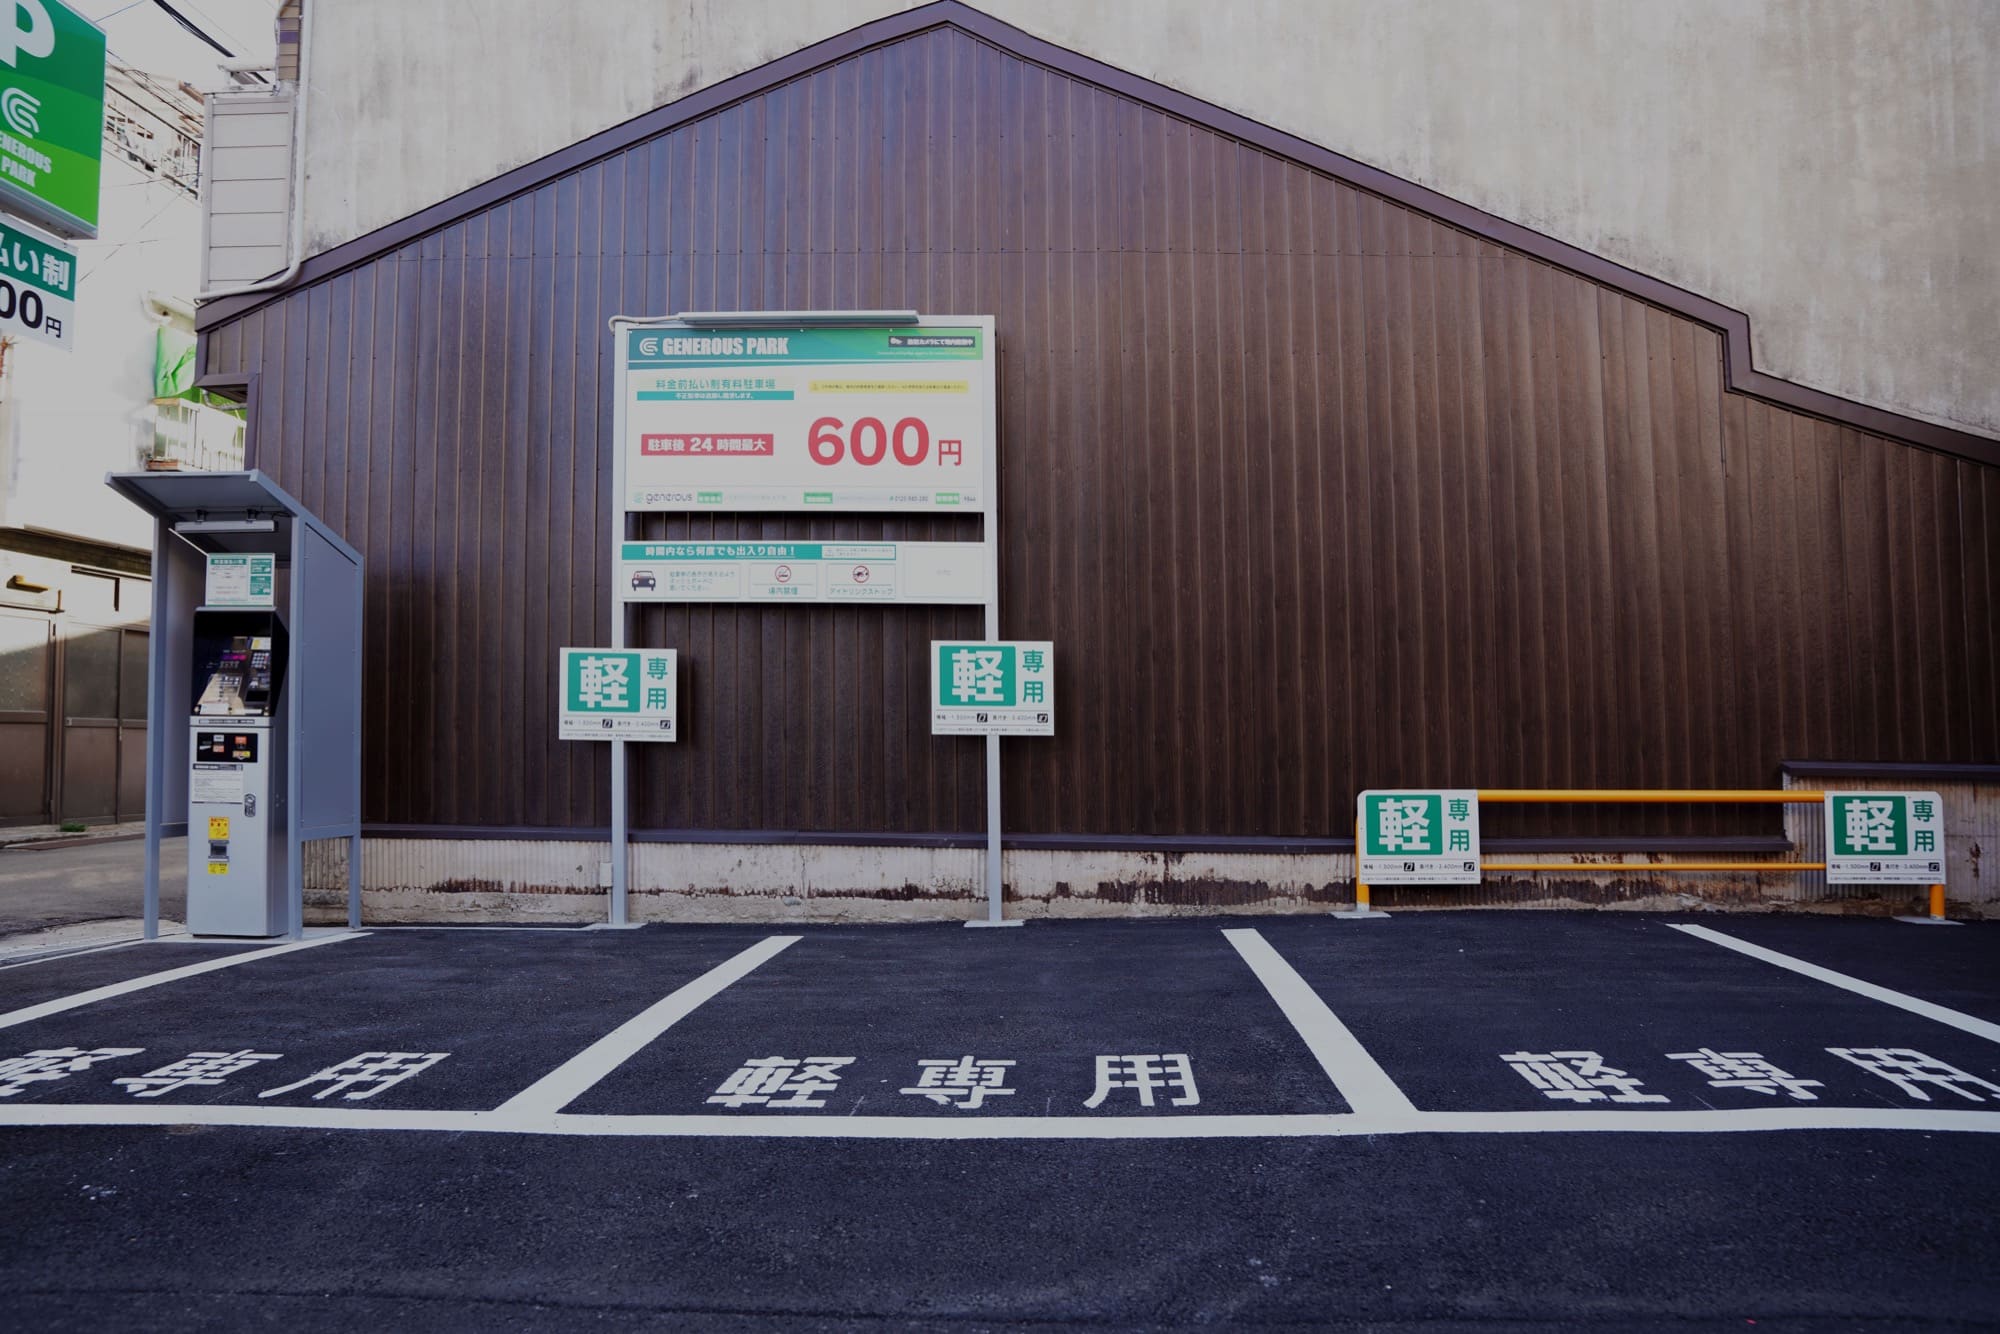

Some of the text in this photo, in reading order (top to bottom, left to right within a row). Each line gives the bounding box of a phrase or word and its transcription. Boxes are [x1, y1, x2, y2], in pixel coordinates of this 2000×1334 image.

[0, 0, 55, 68] P
[1, 155, 36, 188] PARK
[662, 337, 790, 356] GENEROUS PARK
[656, 379, 777, 390] 料金前払い制有料駐車場
[579, 655, 629, 709] 軽
[646, 657, 668, 710] 専用
[951, 648, 1004, 702] 軽
[1022, 649, 1045, 703] 専用
[1378, 798, 1431, 852] 軽
[1448, 798, 1470, 852] 専用
[1844, 799, 1897, 852] 軽
[1912, 799, 1935, 852] 専用
